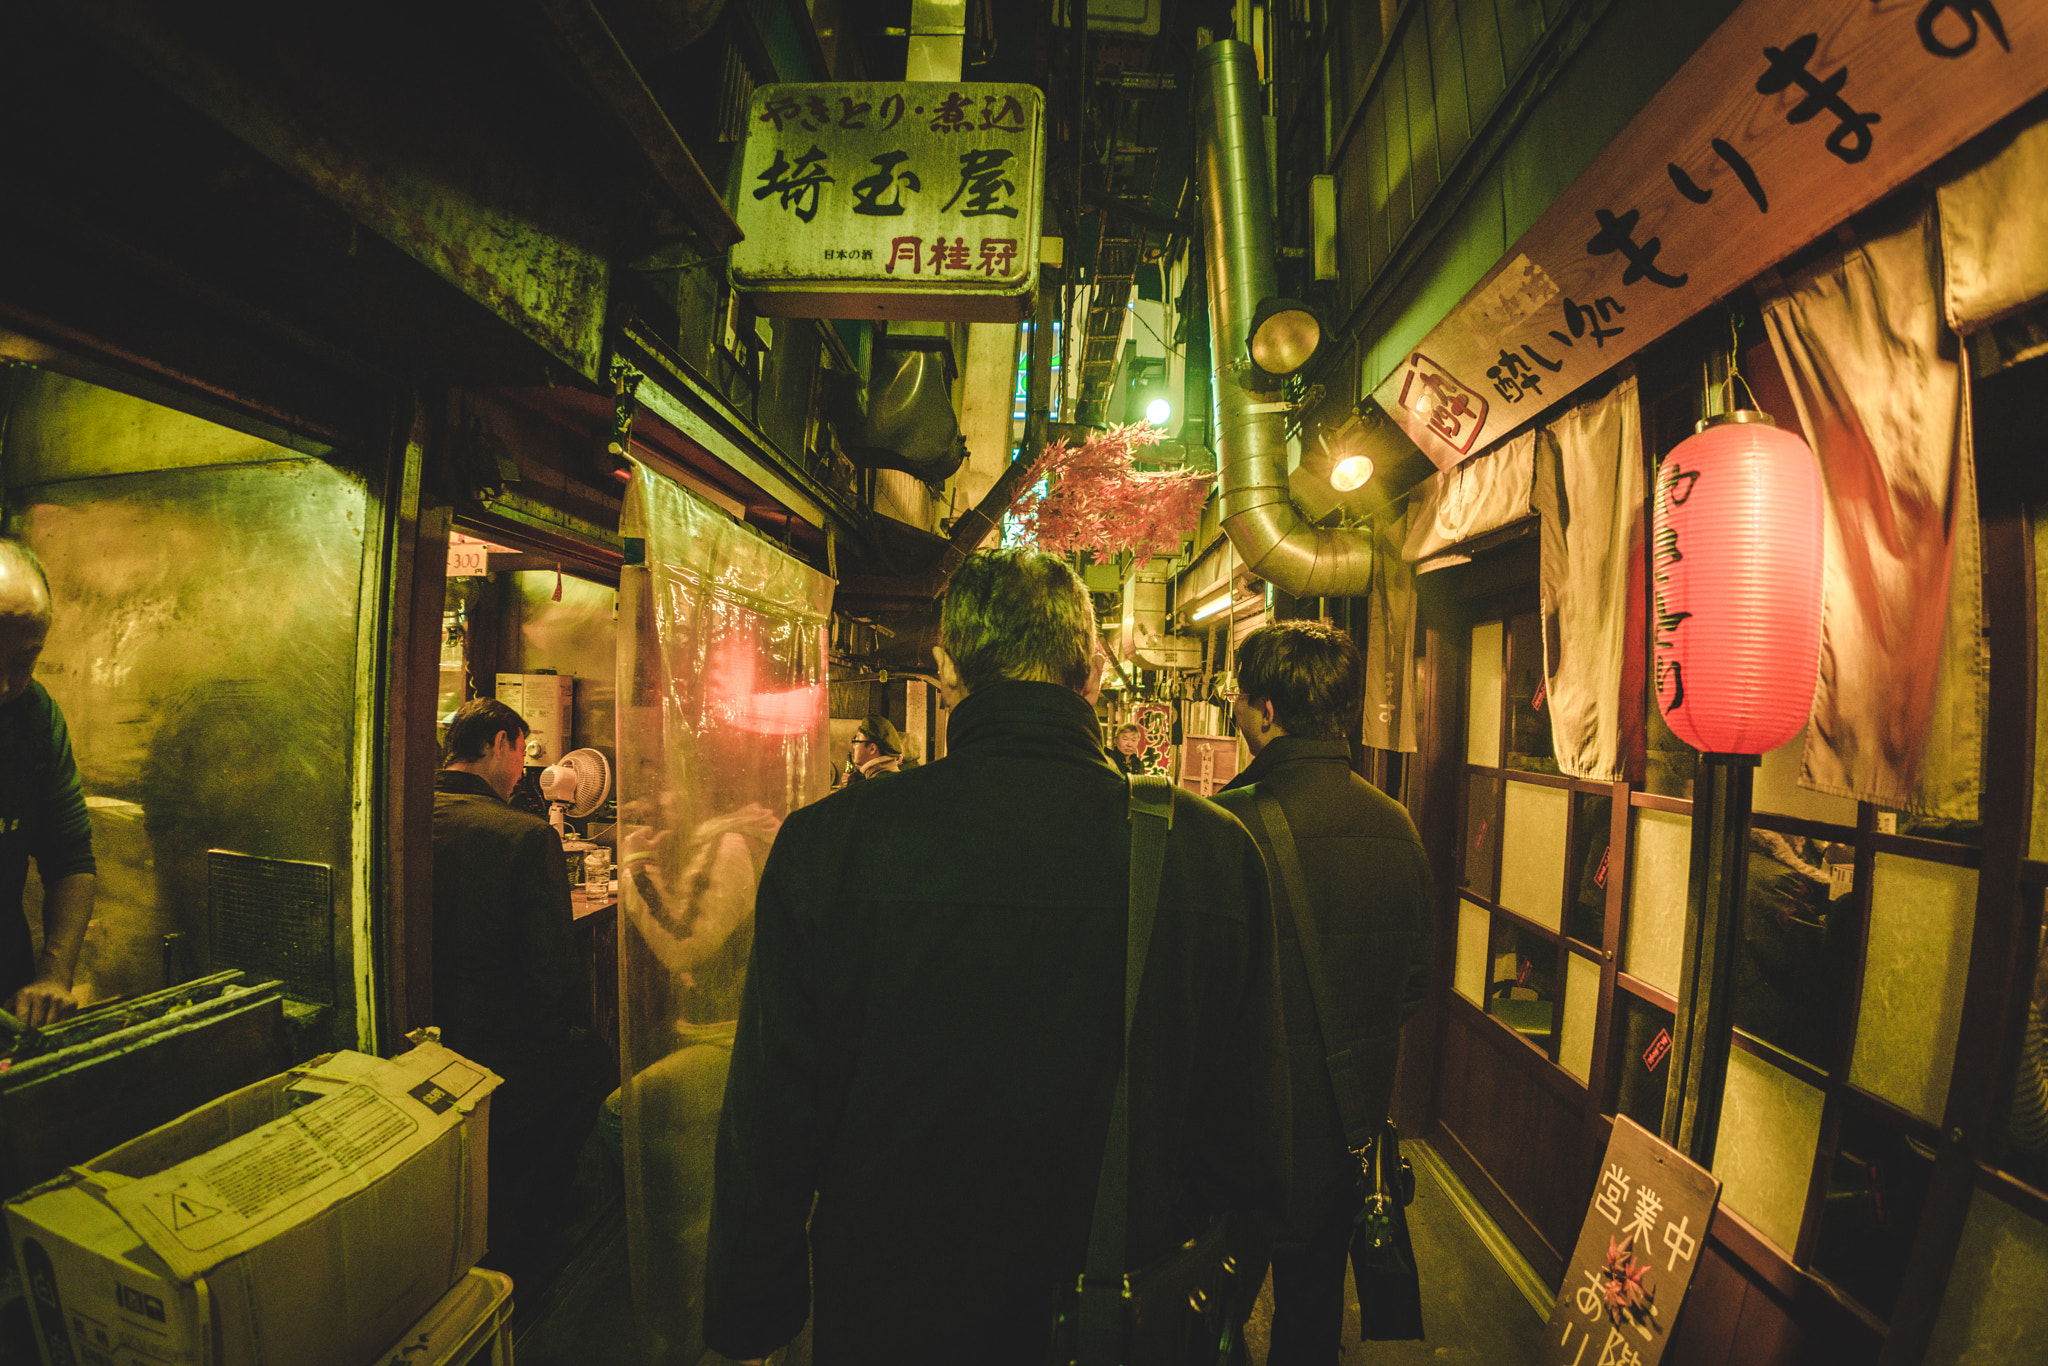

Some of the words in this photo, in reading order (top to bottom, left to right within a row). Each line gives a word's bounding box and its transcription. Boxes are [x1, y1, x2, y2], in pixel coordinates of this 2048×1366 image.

[753, 145, 1019, 224] 埼玉屋
[824, 249, 873, 261] 日本の酒
[885, 236, 1018, 276] 月桂冠
[453, 553, 480, 569] 300
[1595, 1163, 1696, 1272] 営業中
